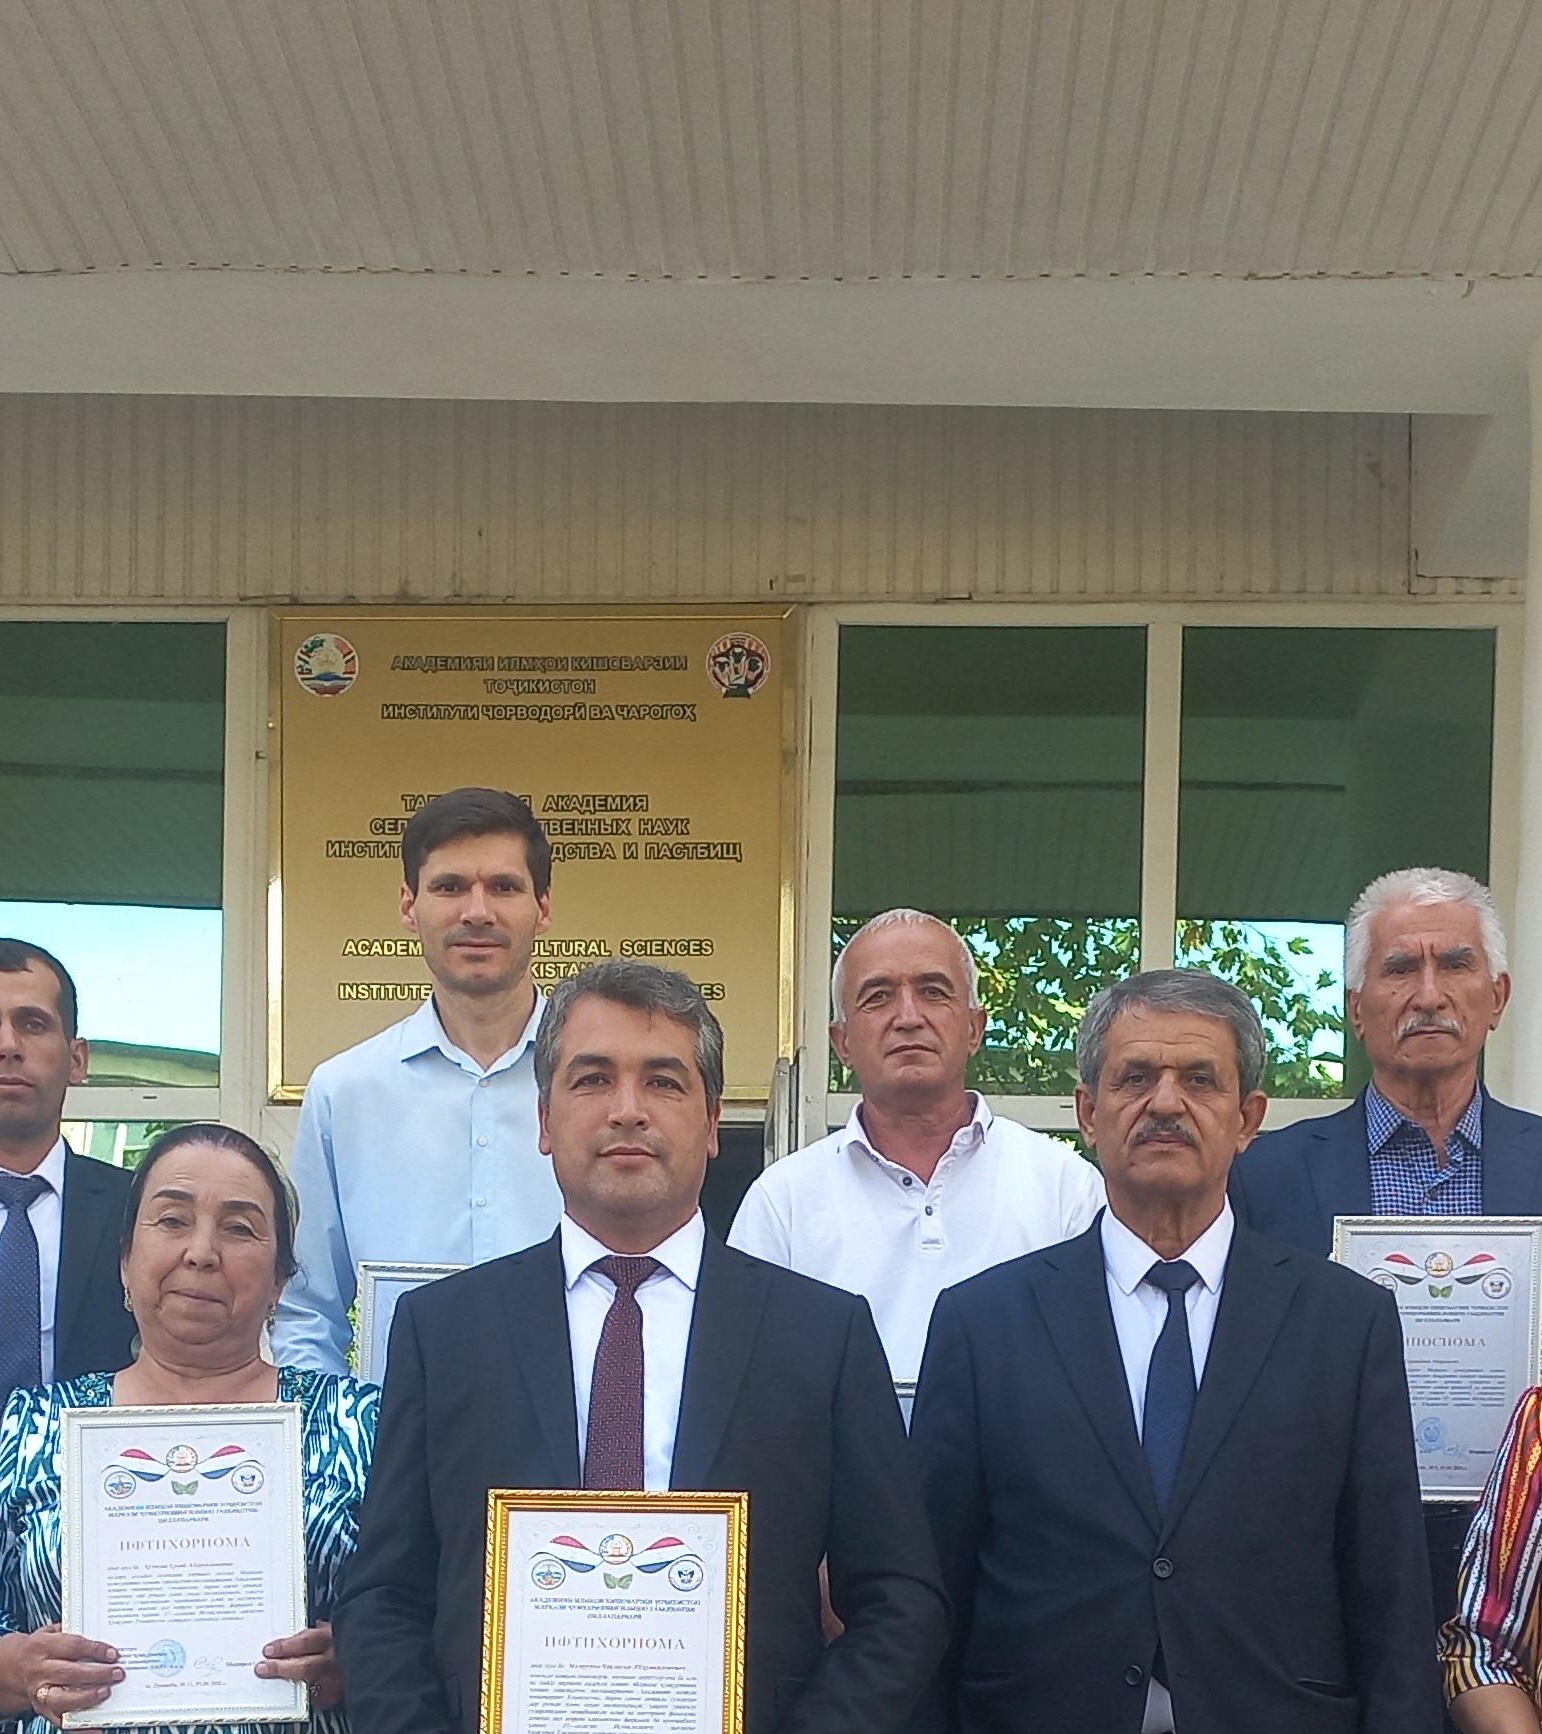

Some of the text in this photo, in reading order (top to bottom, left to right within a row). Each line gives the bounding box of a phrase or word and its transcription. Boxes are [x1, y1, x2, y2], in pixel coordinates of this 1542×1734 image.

[391, 655, 495, 673] АКАДЕМИЯИ
[571, 656, 687, 671] КИШОВАРЗИИ
[382, 704, 479, 720] ИНСТИТУТИ
[589, 705, 615, 720] ВА
[542, 795, 648, 813] АКАДЕМИЯ
[639, 818, 689, 835] НАУК
[326, 841, 402, 858] ИНСТИТ
[624, 843, 638, 858] И
[646, 842, 742, 861] ПАСТБИЩ
[342, 939, 424, 956] ACADEM
[620, 939, 713, 957] SCIENCES
[339, 983, 432, 1000] INSTITUTE
